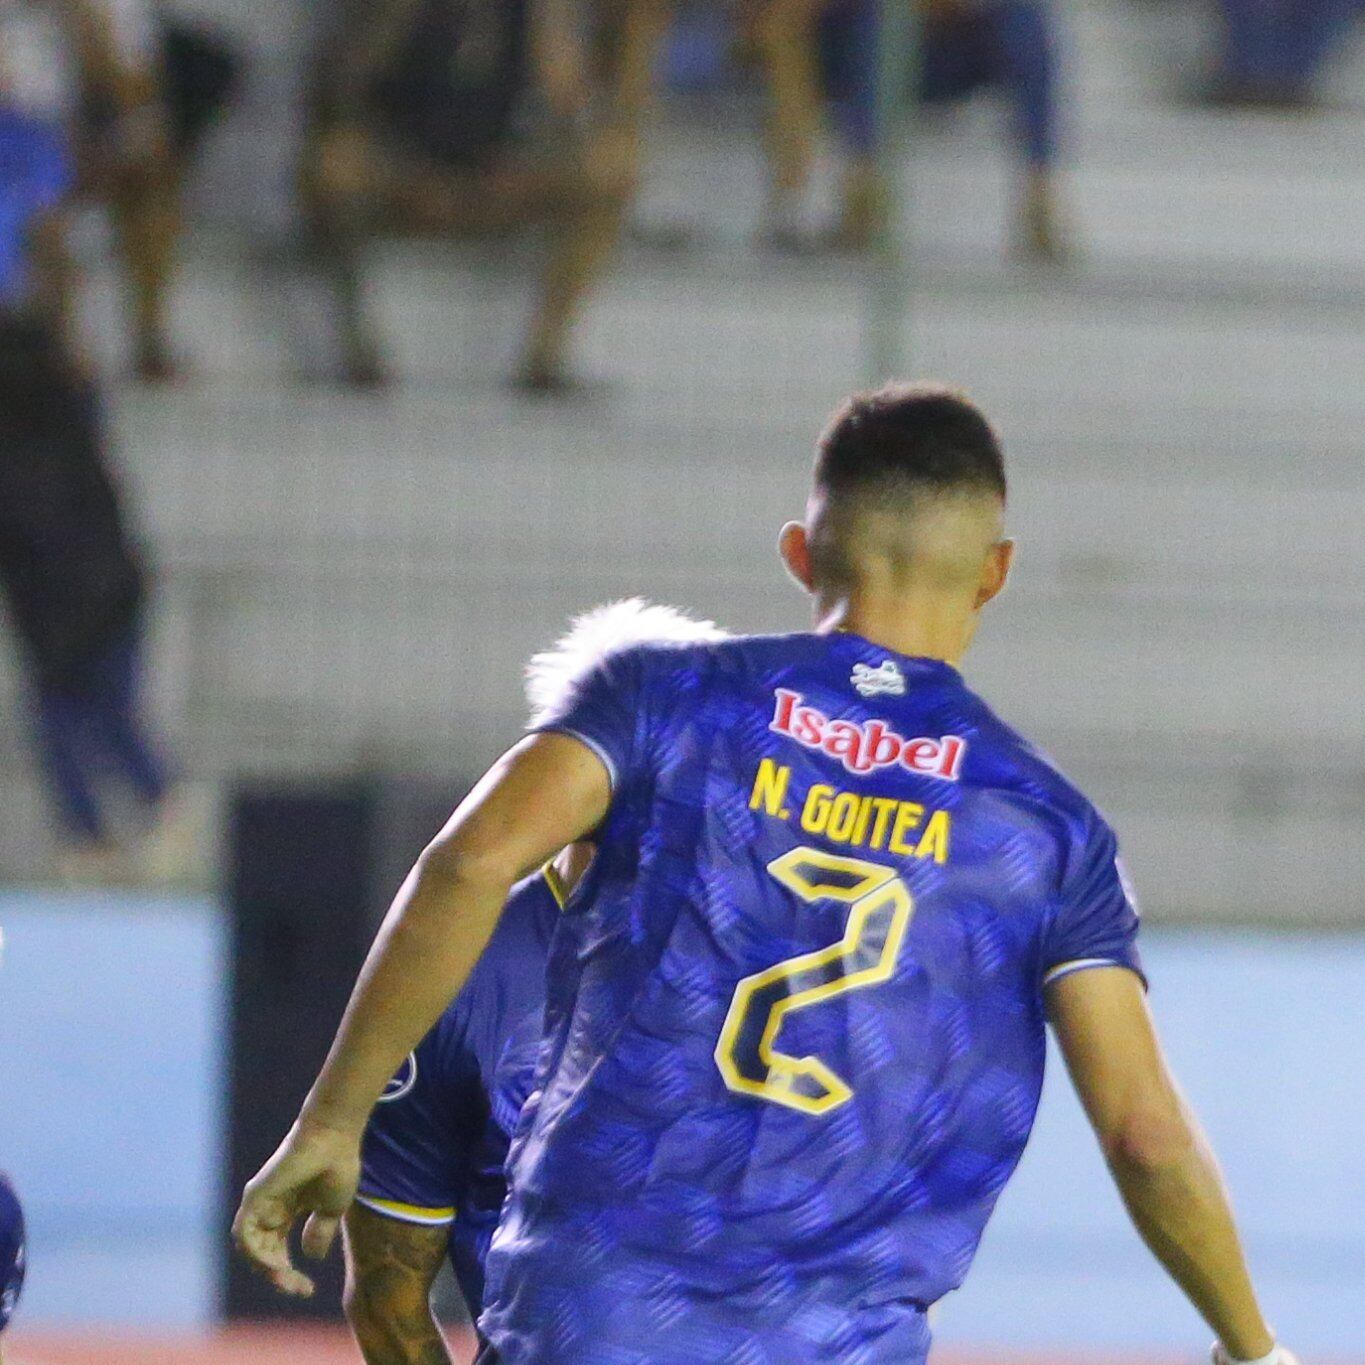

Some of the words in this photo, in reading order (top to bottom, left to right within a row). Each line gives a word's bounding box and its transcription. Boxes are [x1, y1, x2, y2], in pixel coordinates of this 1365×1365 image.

[769, 688, 965, 781] Isabel
[749, 758, 792, 820] N.
[800, 783, 952, 864] GOITEA
[714, 848, 912, 1114] 2
